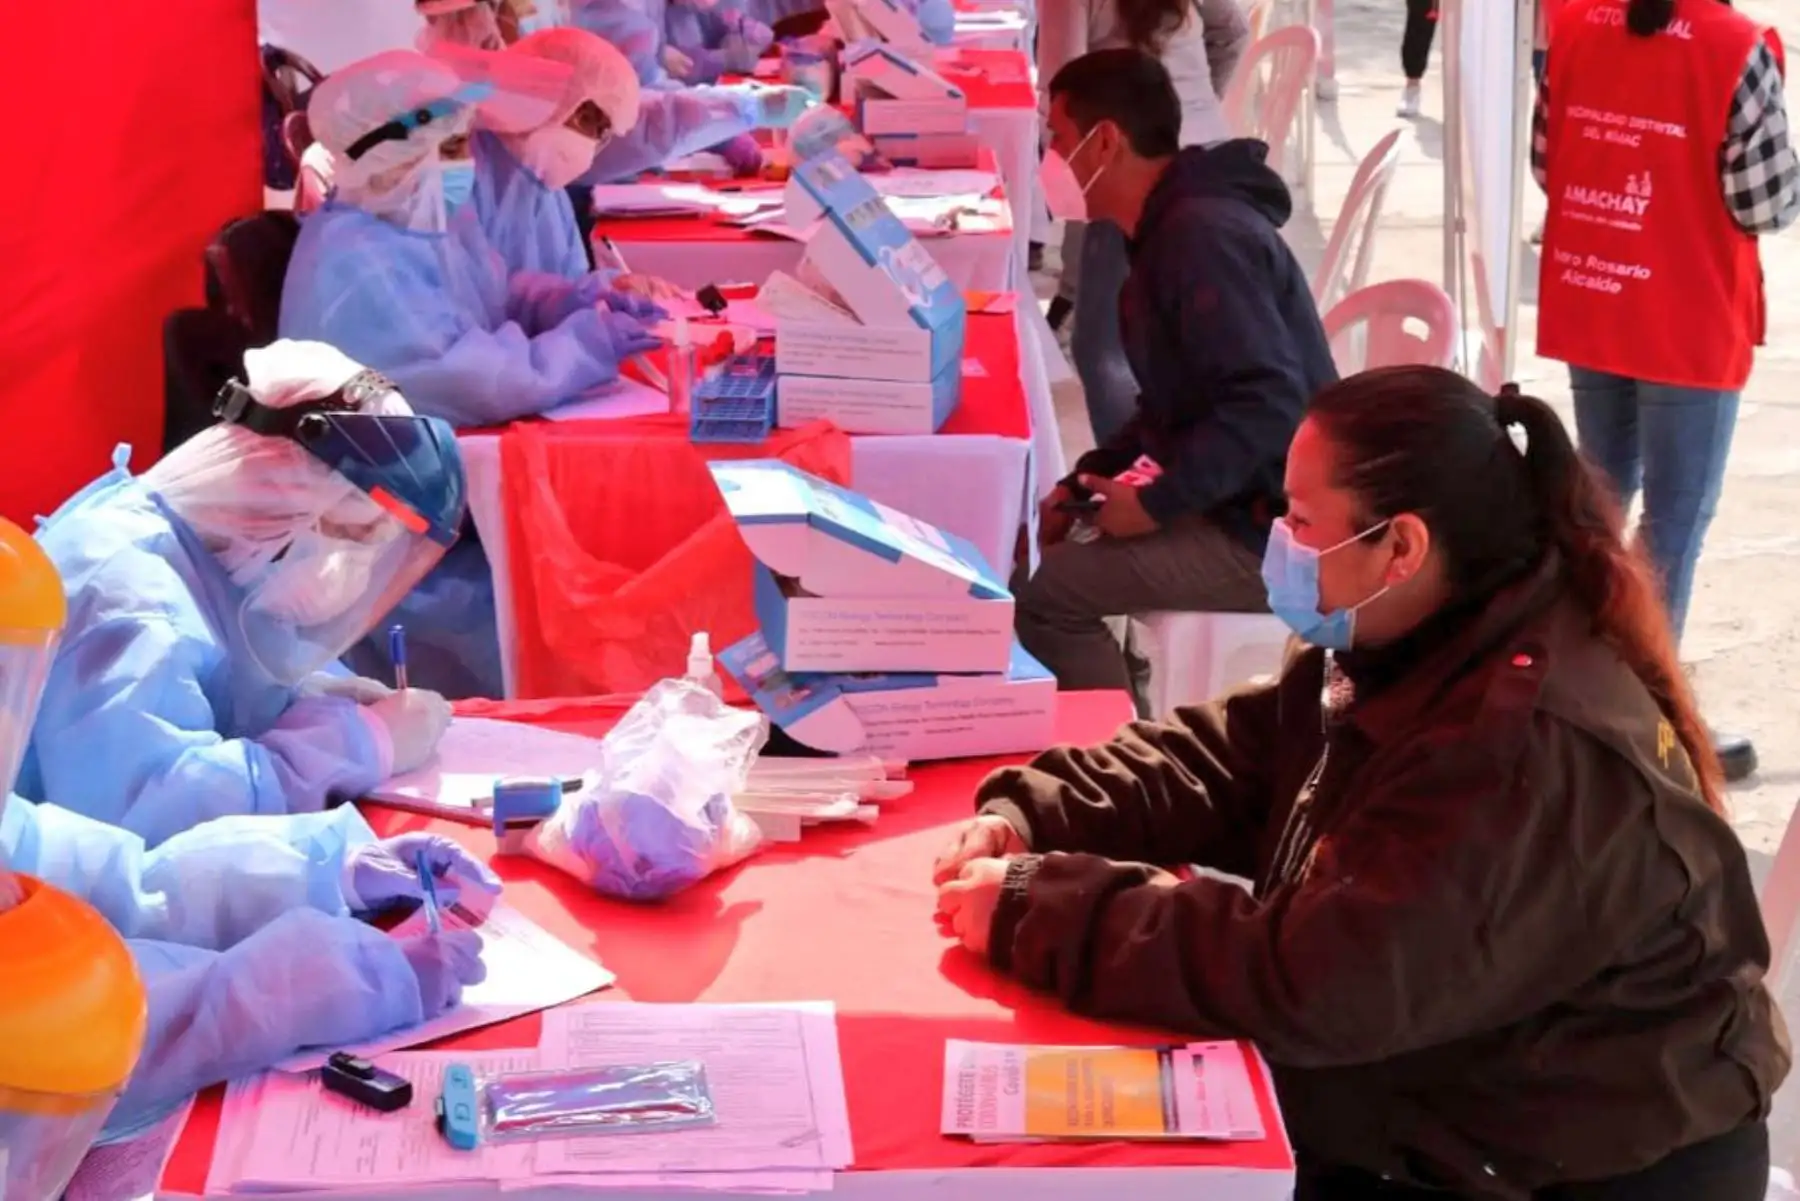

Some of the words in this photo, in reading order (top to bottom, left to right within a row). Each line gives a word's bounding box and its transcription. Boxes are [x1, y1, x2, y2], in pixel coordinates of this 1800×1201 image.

[1585, 5, 1627, 27] ACTO
[1628, 116, 1687, 139] DISTRITAL
[1563, 184, 1651, 216] AMACHAY
[1585, 254, 1652, 280] Rosario
[1560, 268, 1623, 295] Alcalde
